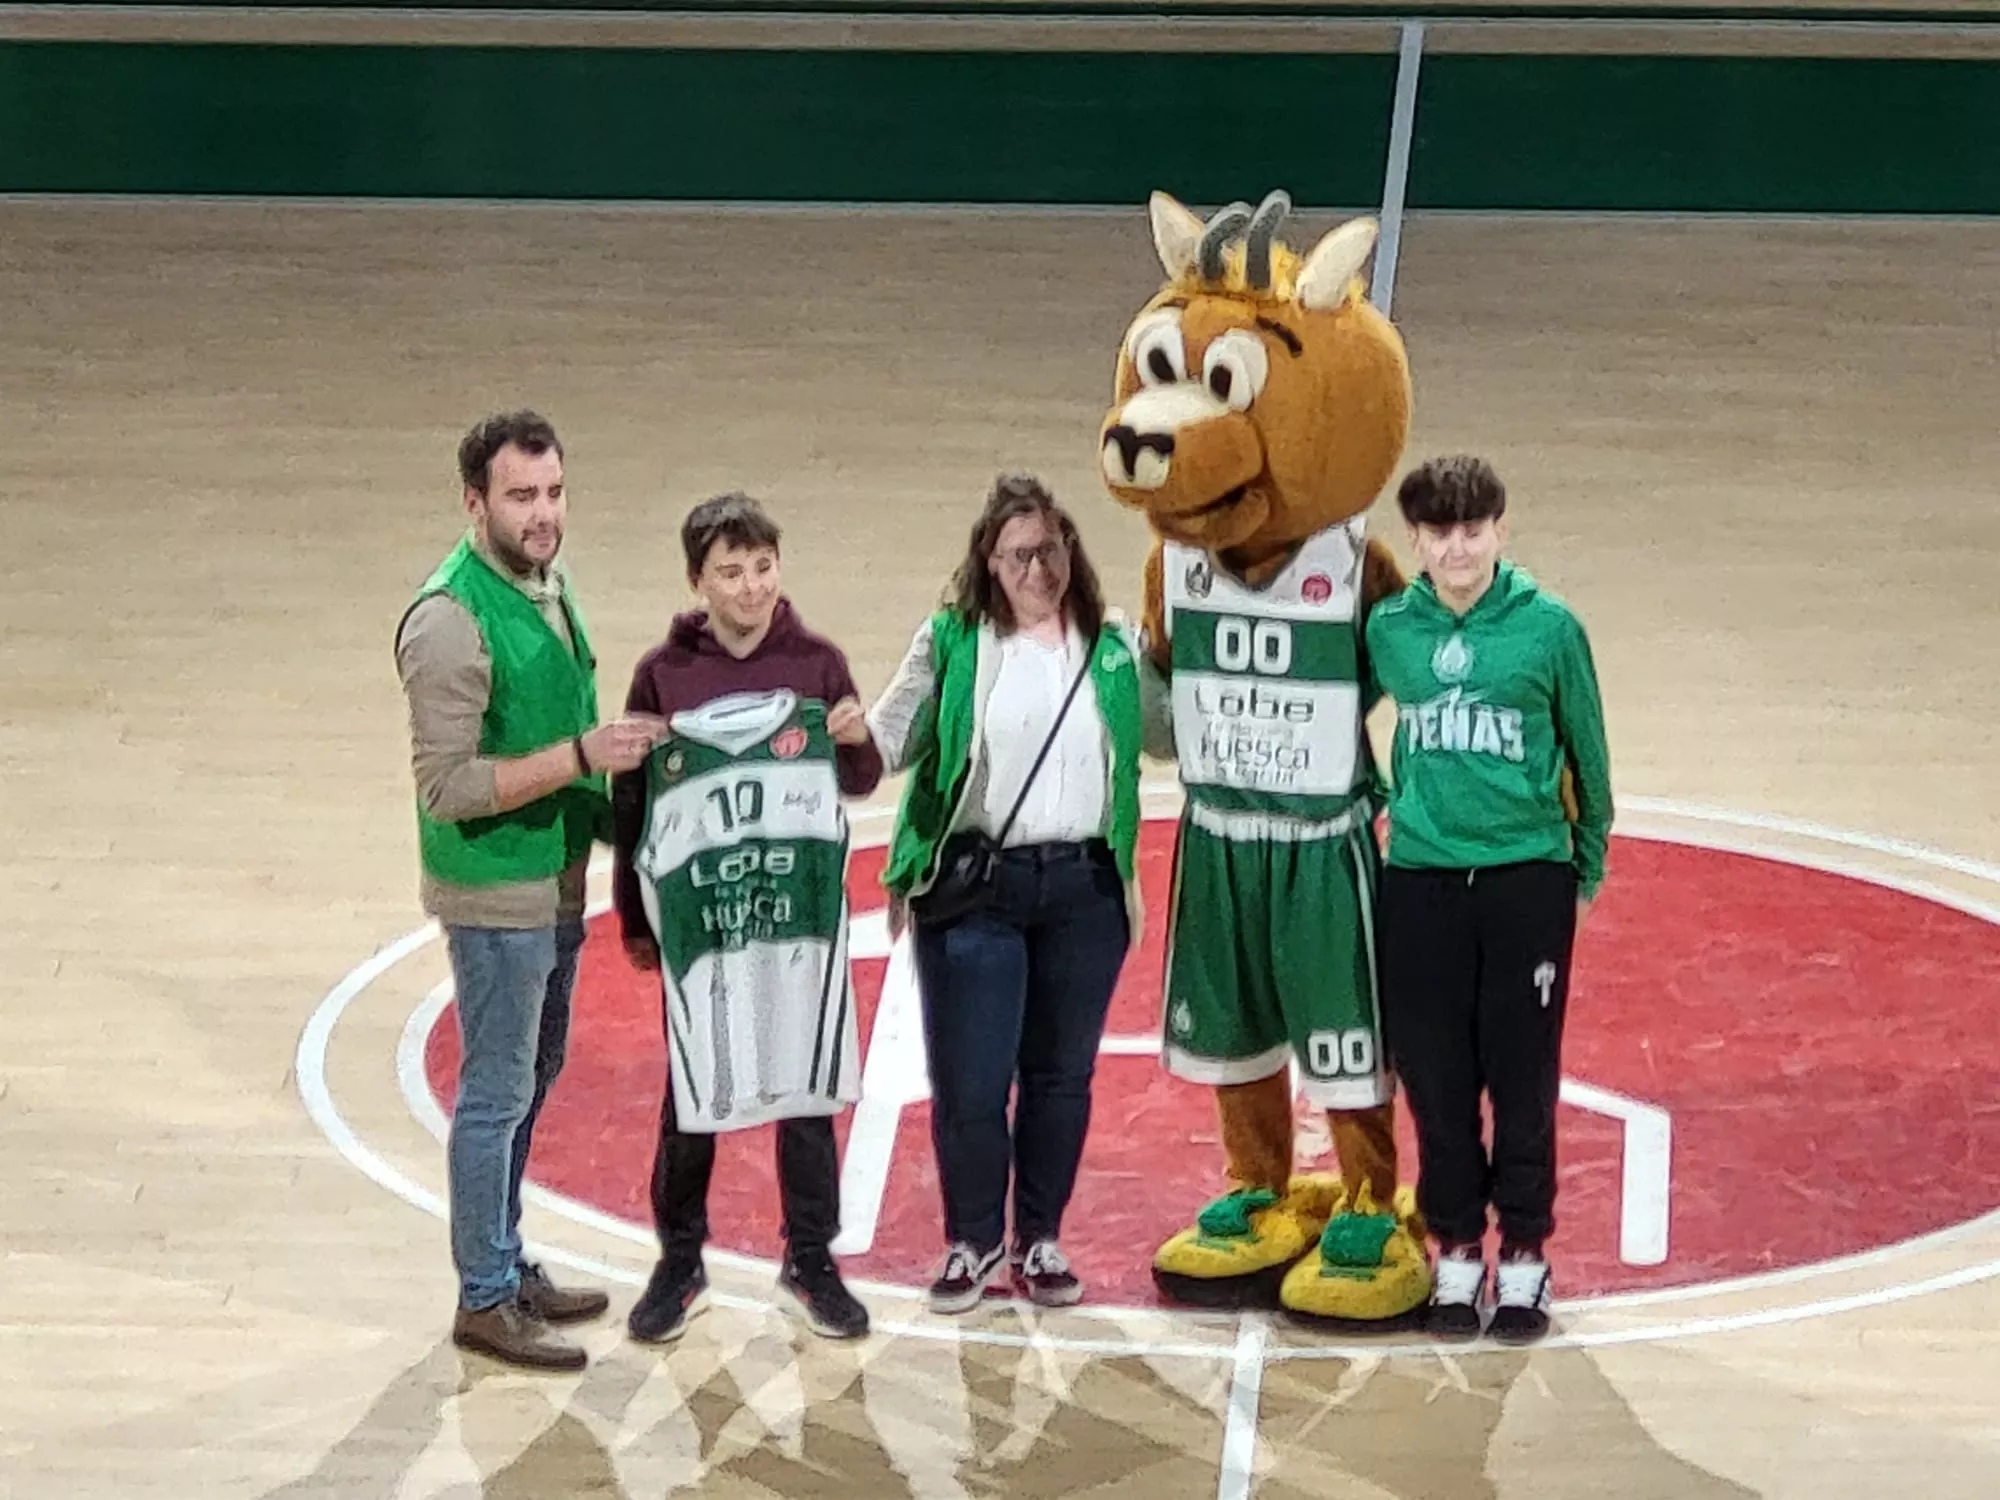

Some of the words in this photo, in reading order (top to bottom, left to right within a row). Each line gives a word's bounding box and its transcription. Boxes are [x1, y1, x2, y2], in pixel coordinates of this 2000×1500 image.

[1215, 616, 1292, 675] 00
[1195, 683, 1314, 723] Lobe
[705, 780, 764, 833] 10
[1308, 1027, 1374, 1076] 00
